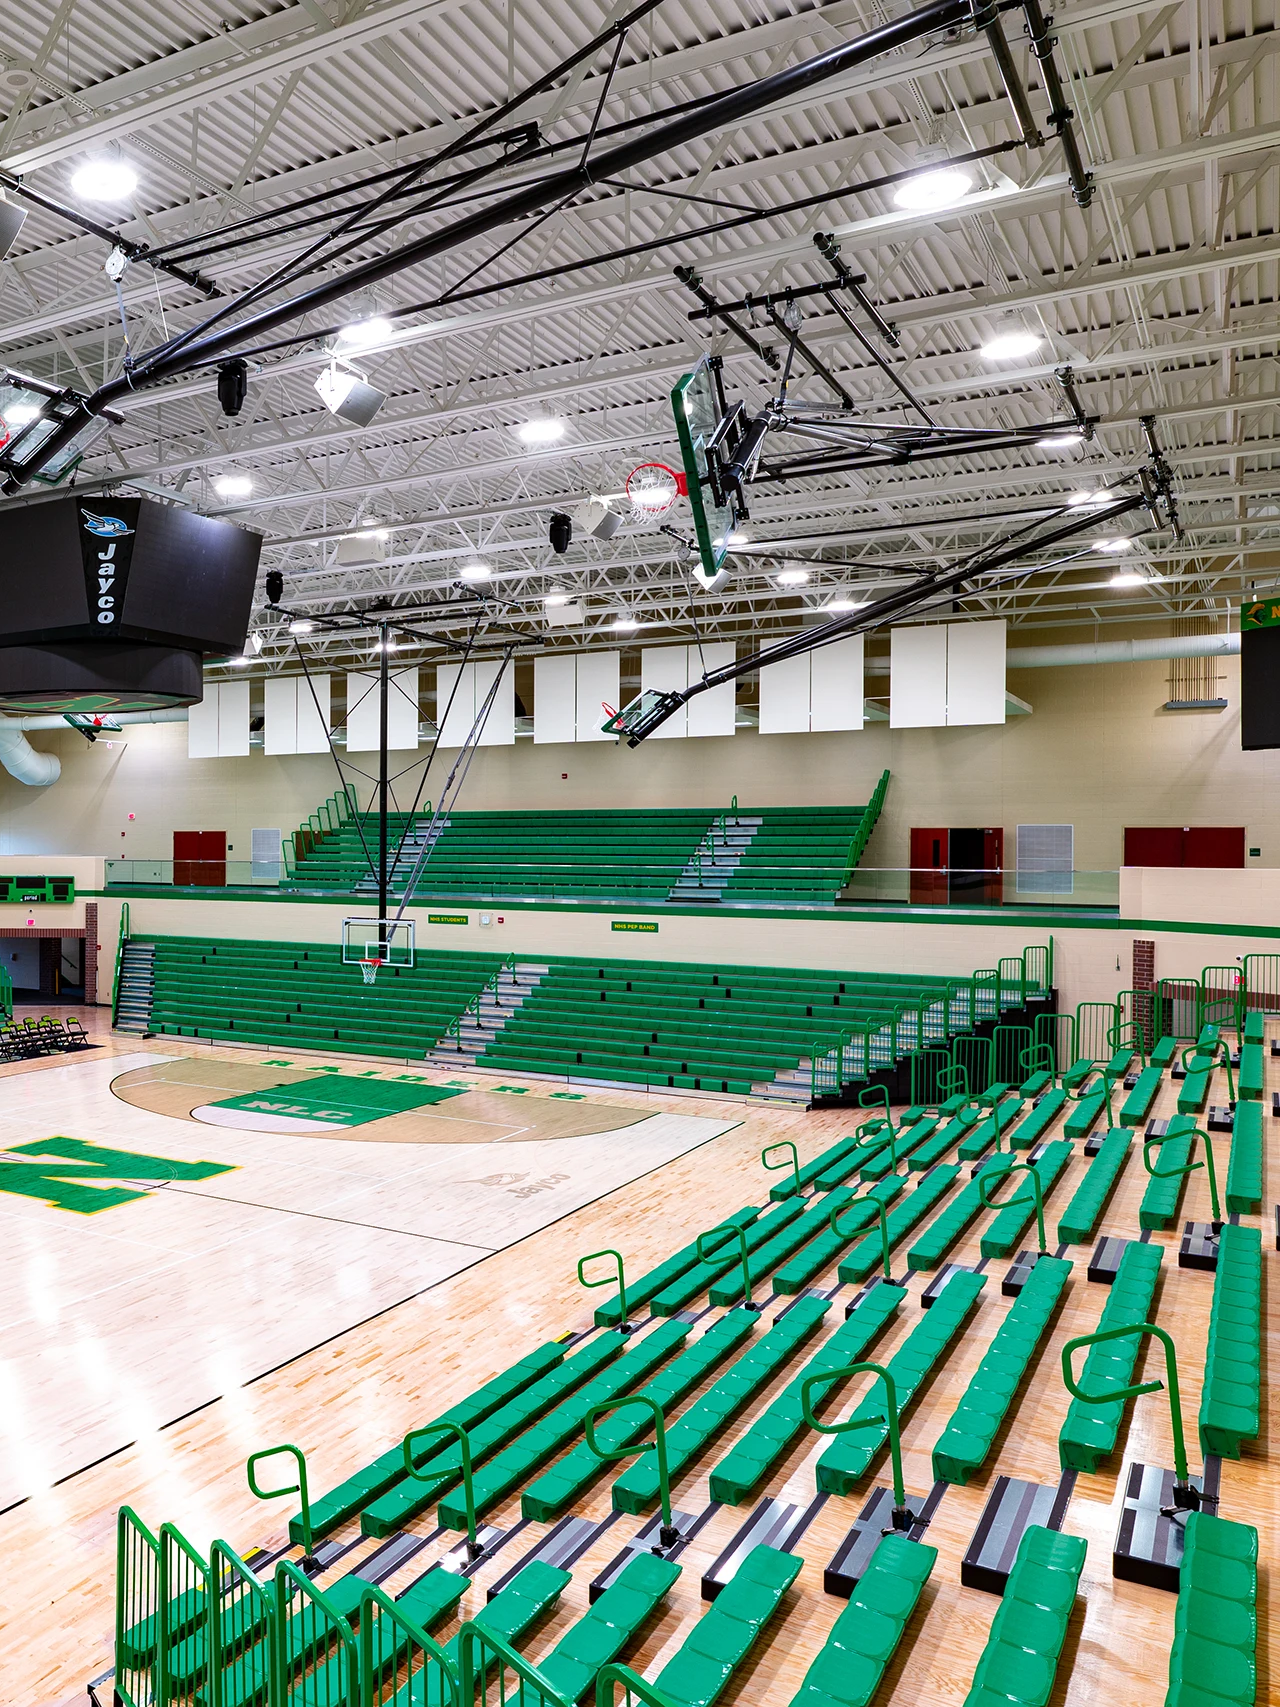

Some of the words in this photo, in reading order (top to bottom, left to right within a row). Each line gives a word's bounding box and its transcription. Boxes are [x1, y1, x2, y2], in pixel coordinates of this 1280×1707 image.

[97, 543, 117, 624] Jayco
[259, 1059, 589, 1101] RAIDERS
[239, 1099, 354, 1121] NLC
[506, 1173, 571, 1199] Jayco
